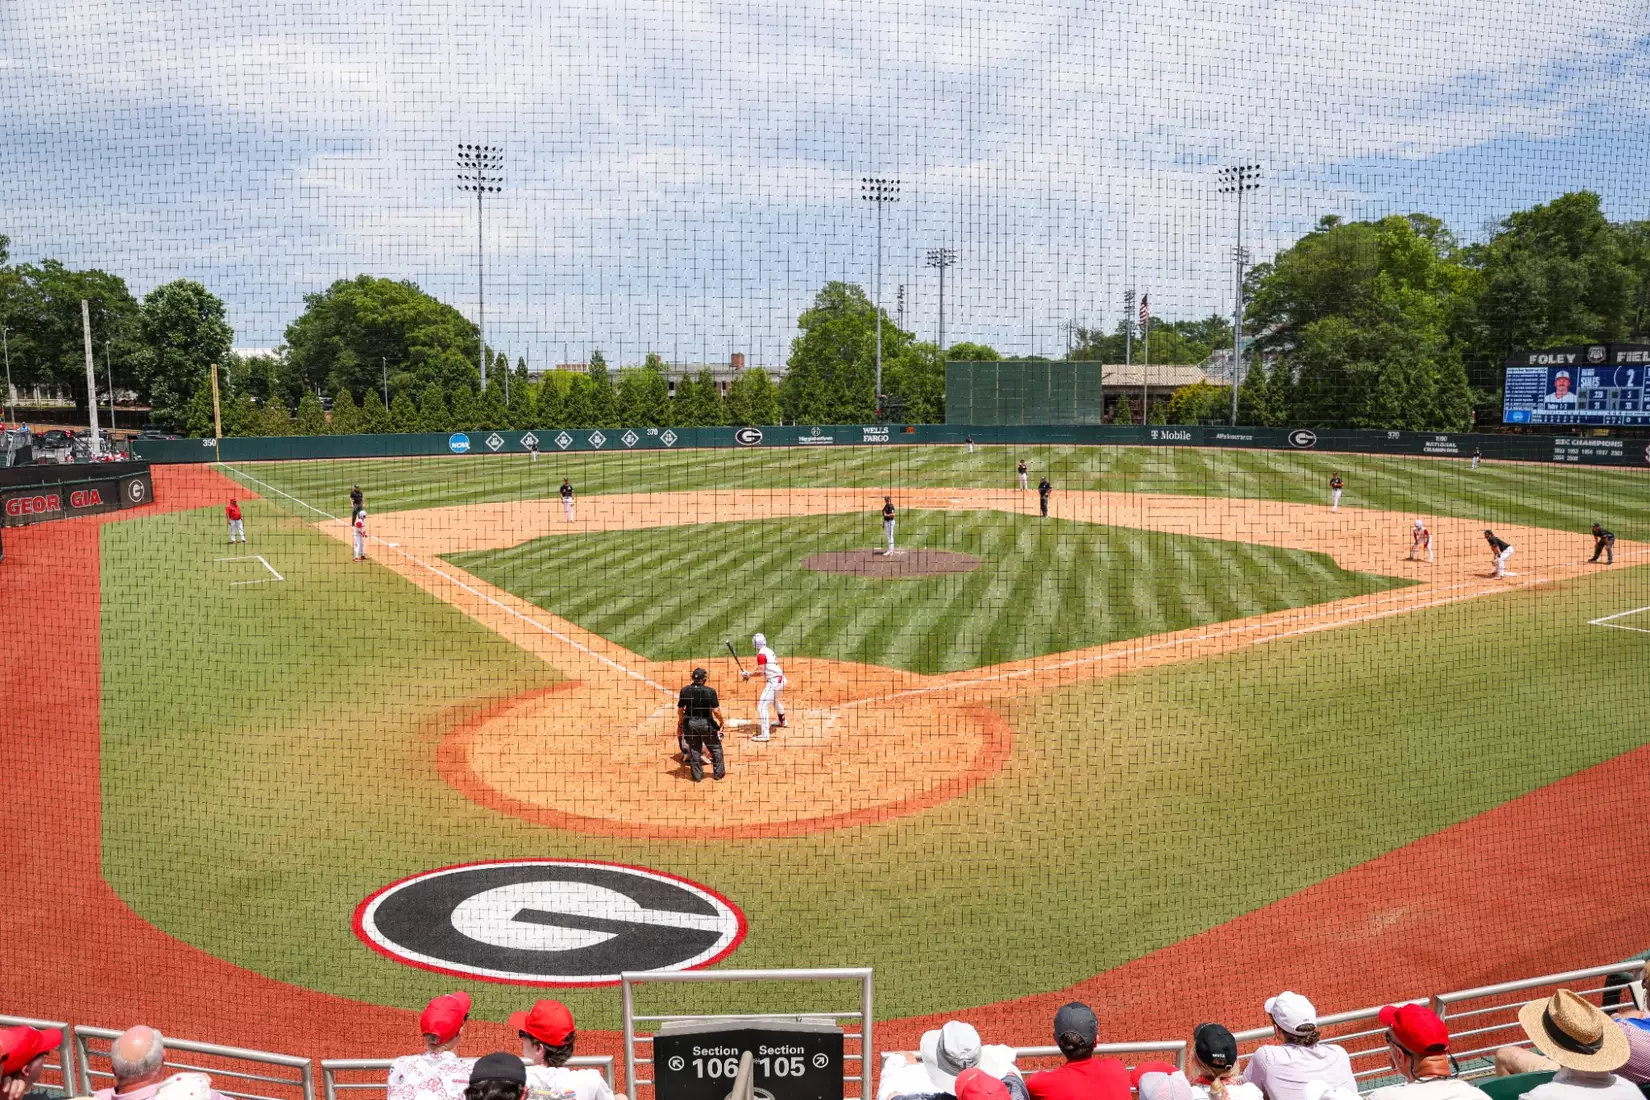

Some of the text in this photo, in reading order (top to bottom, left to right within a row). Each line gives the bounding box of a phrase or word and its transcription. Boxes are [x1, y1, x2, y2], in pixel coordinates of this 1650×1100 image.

[1529, 353, 1576, 365] FOLEY
[1626, 369, 1635, 387] 2
[647, 428, 658, 436] 370
[1160, 430, 1191, 440] Mobile
[1387, 431, 1400, 439] 370
[202, 439, 217, 447] 350
[1571, 440, 1623, 448] CHAMPIONS
[6, 489, 103, 516] GEOR GIA
[692, 1045, 805, 1056] Section Section
[692, 1056, 806, 1079] 106 105
